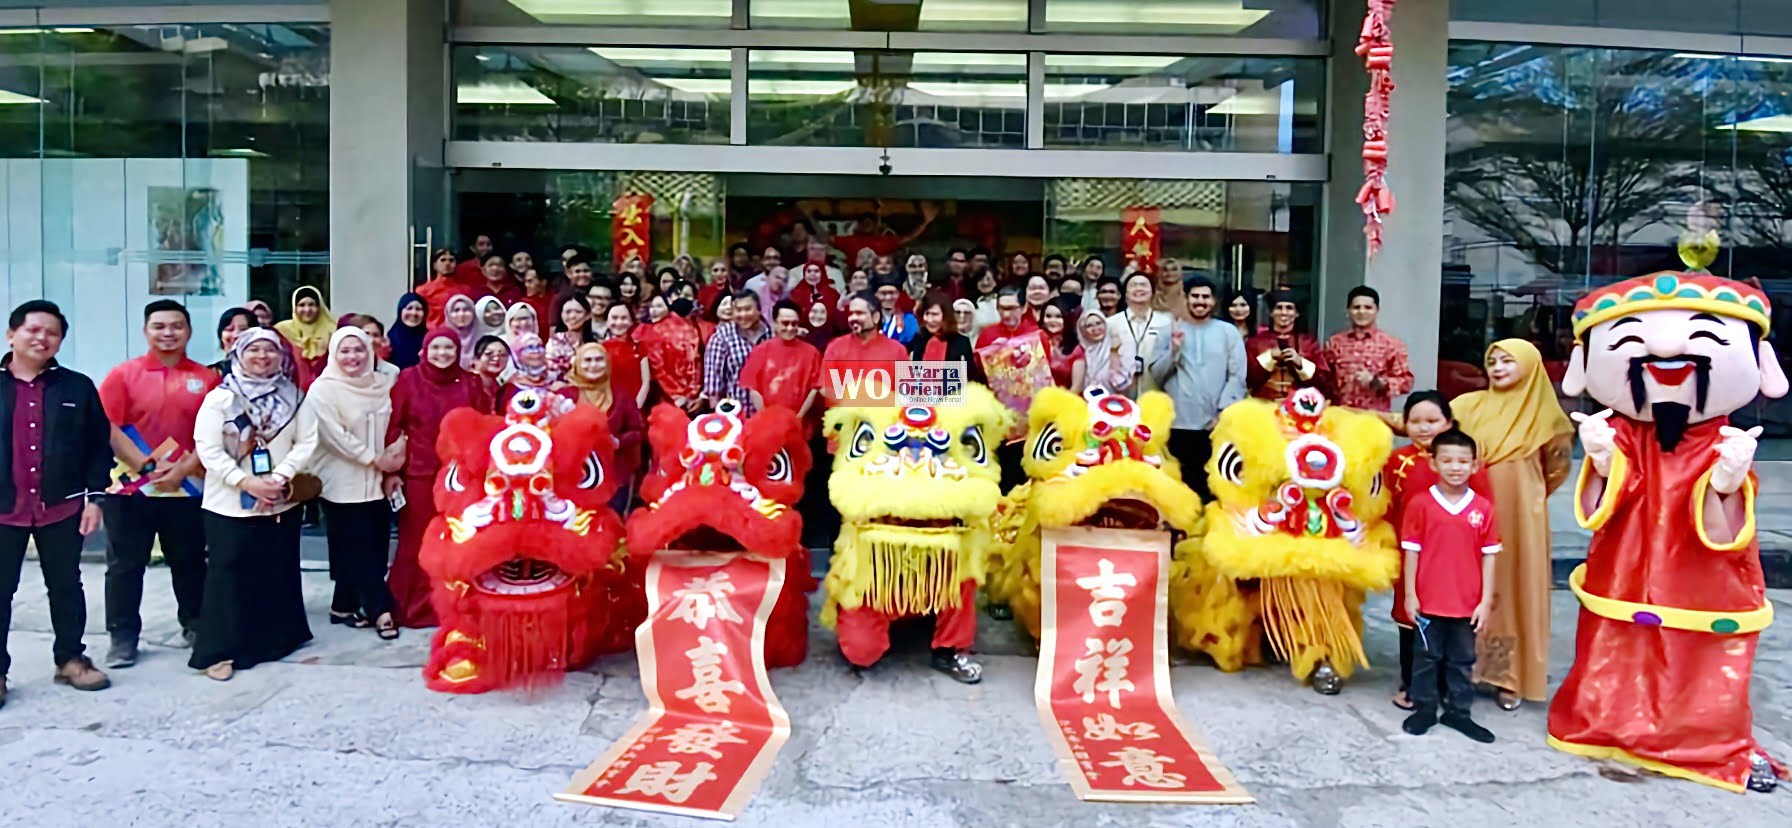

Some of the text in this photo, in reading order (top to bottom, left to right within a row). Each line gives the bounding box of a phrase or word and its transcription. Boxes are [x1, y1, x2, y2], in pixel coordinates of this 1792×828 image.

[613, 571, 749, 803] 恭喜發財
[1072, 558, 1187, 788] 吉祥如意
